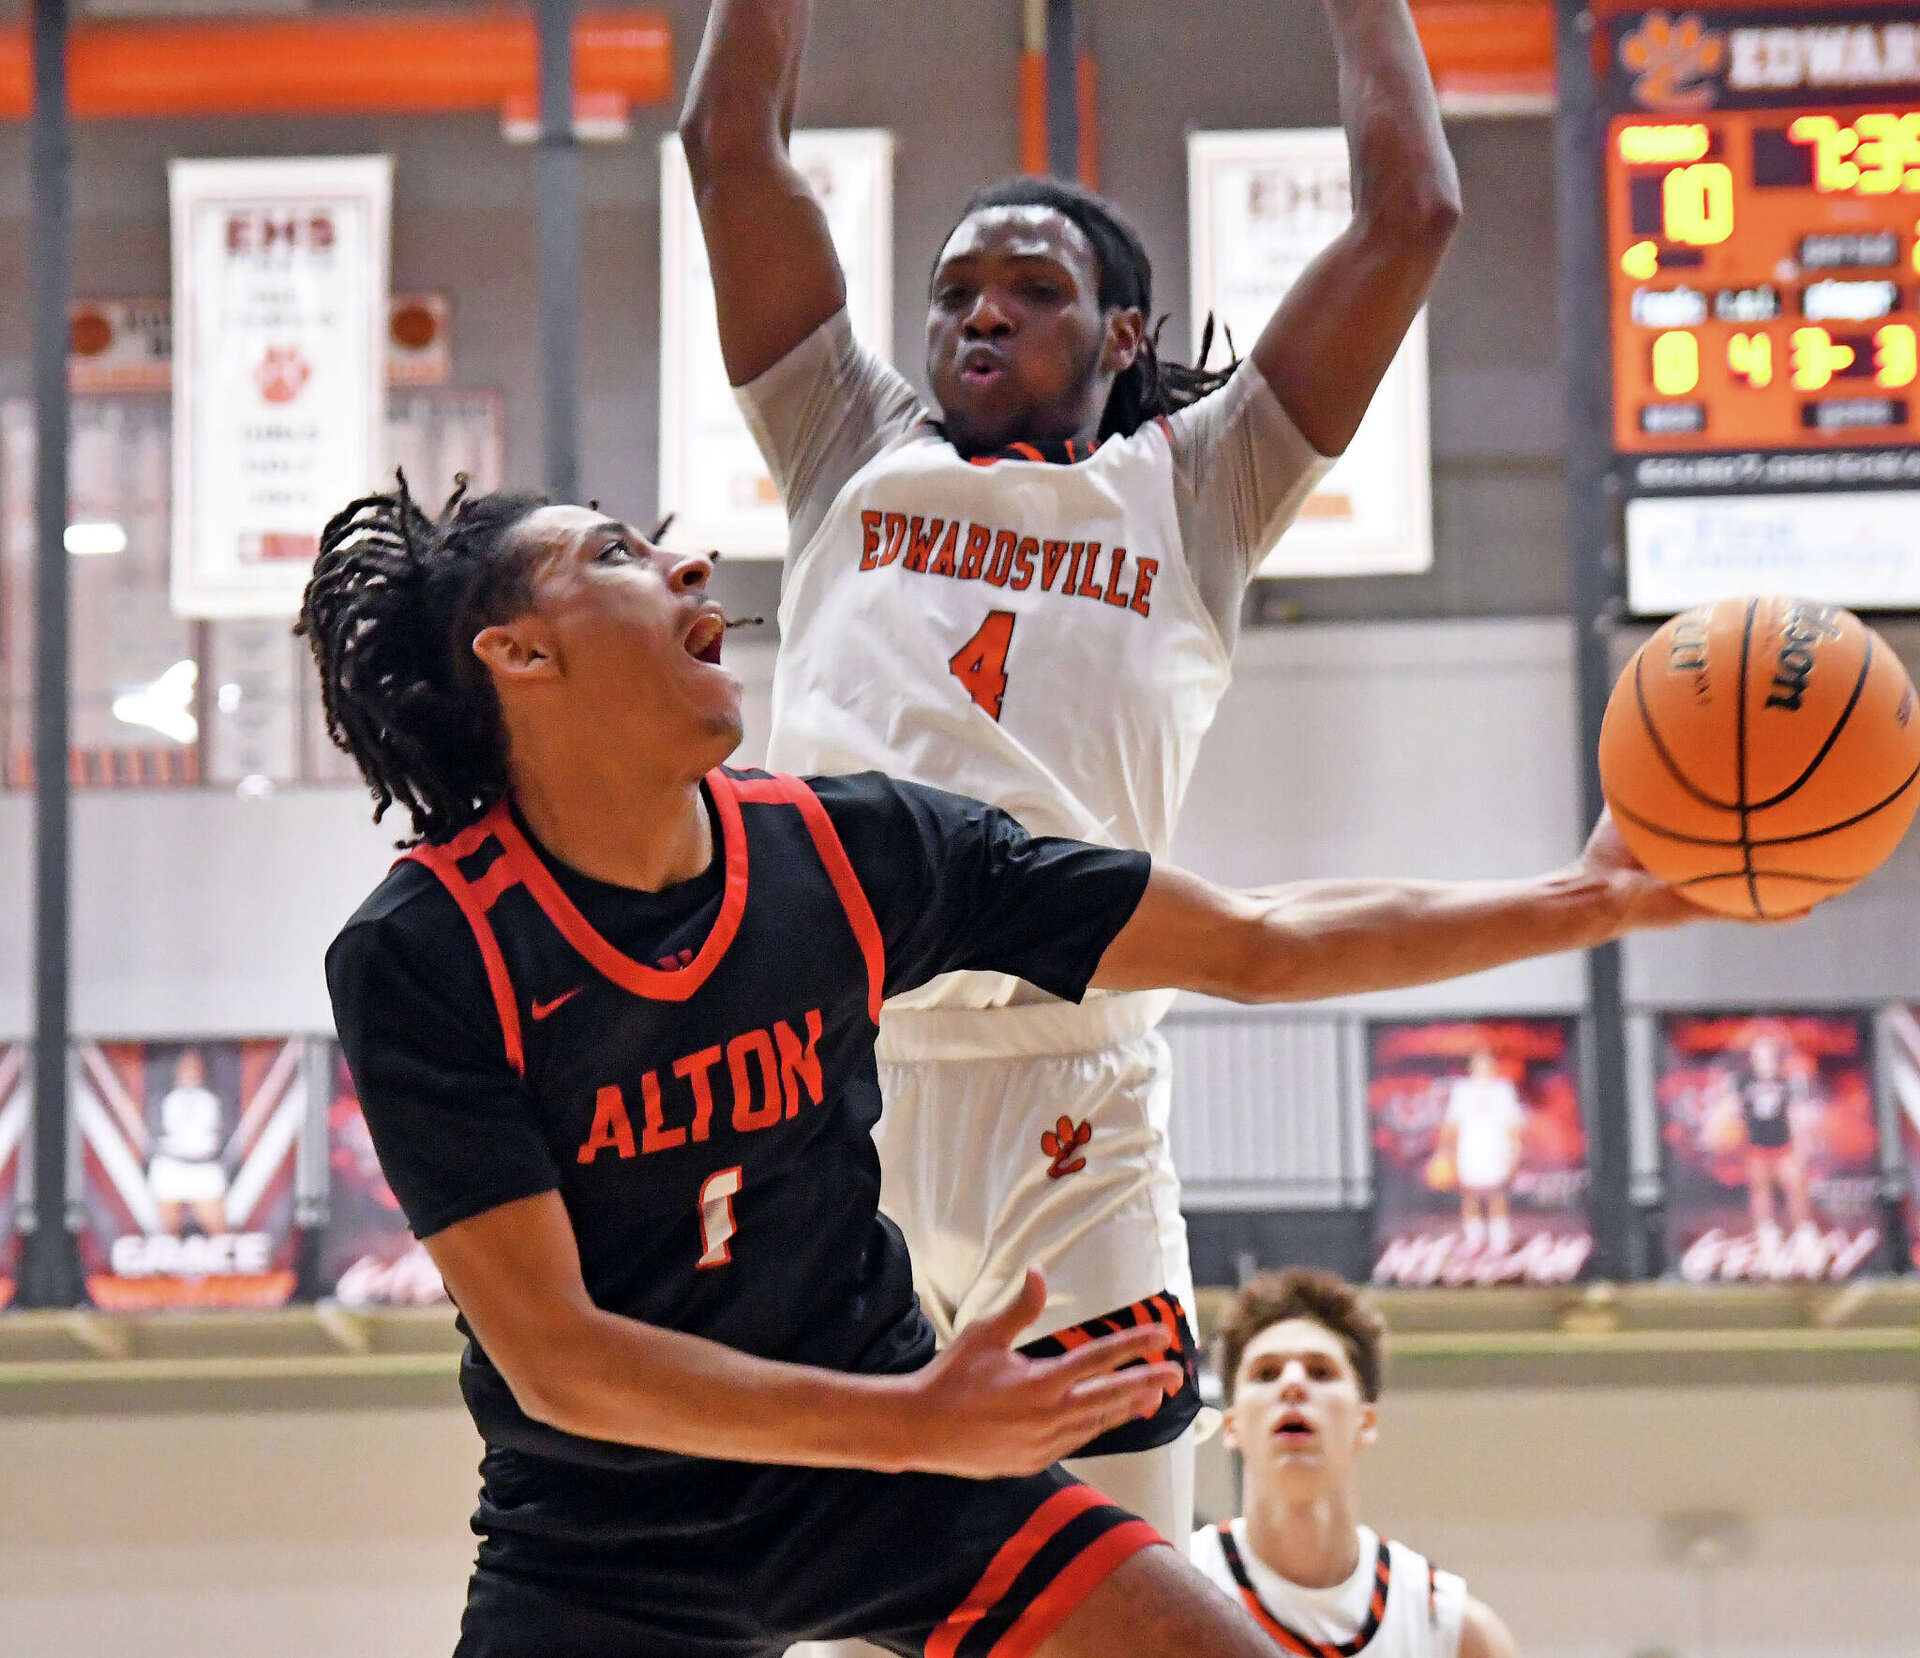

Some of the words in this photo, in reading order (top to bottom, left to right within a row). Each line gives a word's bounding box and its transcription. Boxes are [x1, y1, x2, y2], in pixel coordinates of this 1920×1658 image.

[225, 210, 336, 256] EHS
[1652, 330, 1700, 396] 0
[1727, 331, 1773, 389] 4
[859, 510, 1159, 618] EDWARDSVILLE
[948, 609, 1009, 723] 4
[577, 1008, 823, 1164] ALTON
[695, 1165, 742, 1270] 1
